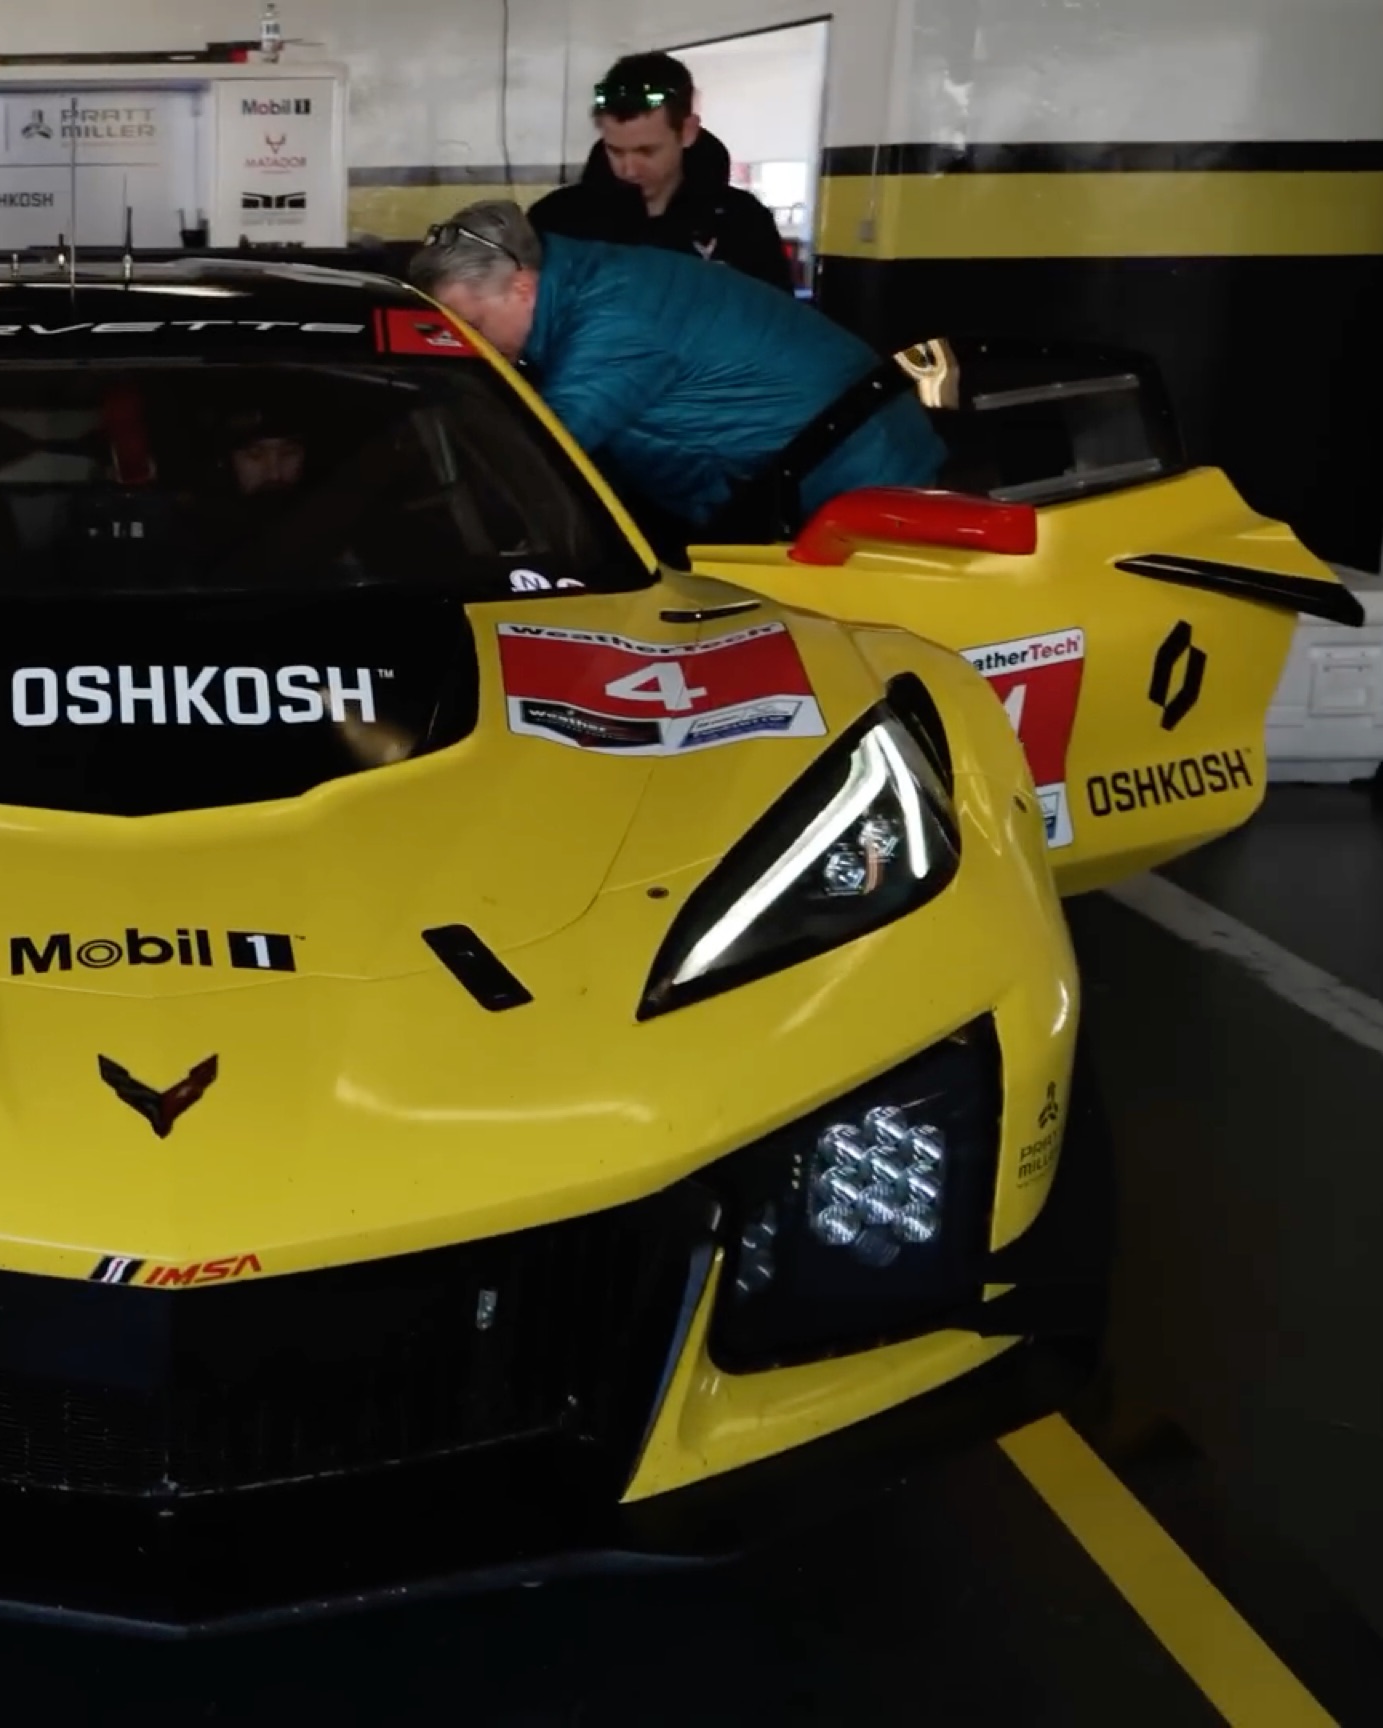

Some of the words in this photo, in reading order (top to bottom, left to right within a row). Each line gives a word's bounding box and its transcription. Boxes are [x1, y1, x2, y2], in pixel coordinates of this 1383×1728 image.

[61, 108, 156, 122] PRATT
[242, 99, 290, 115] Mobil
[61, 124, 157, 138] MILLER
[510, 624, 778, 655] WeatherTech
[605, 661, 708, 711] 4
[10, 928, 213, 976] Mobil
[143, 1254, 262, 1285] IMSA
